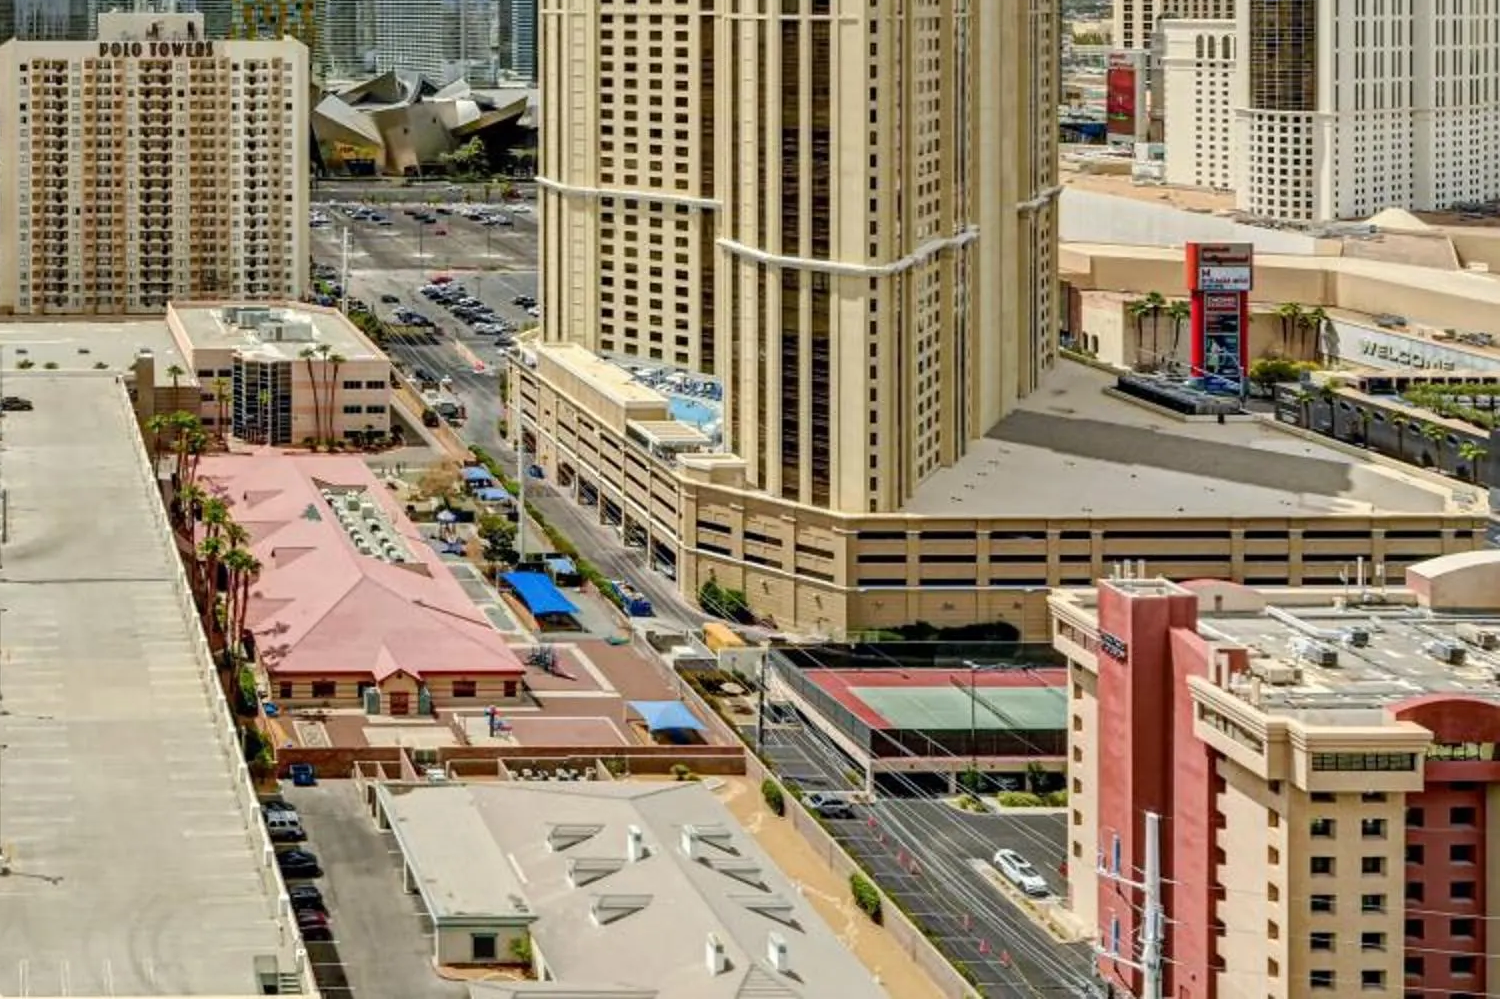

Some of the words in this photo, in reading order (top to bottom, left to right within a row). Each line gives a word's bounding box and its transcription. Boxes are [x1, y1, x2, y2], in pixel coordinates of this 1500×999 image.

[99, 42, 142, 57] POLO
[149, 41, 214, 57] TOWERS
[1361, 339, 1455, 371] WELCOME
